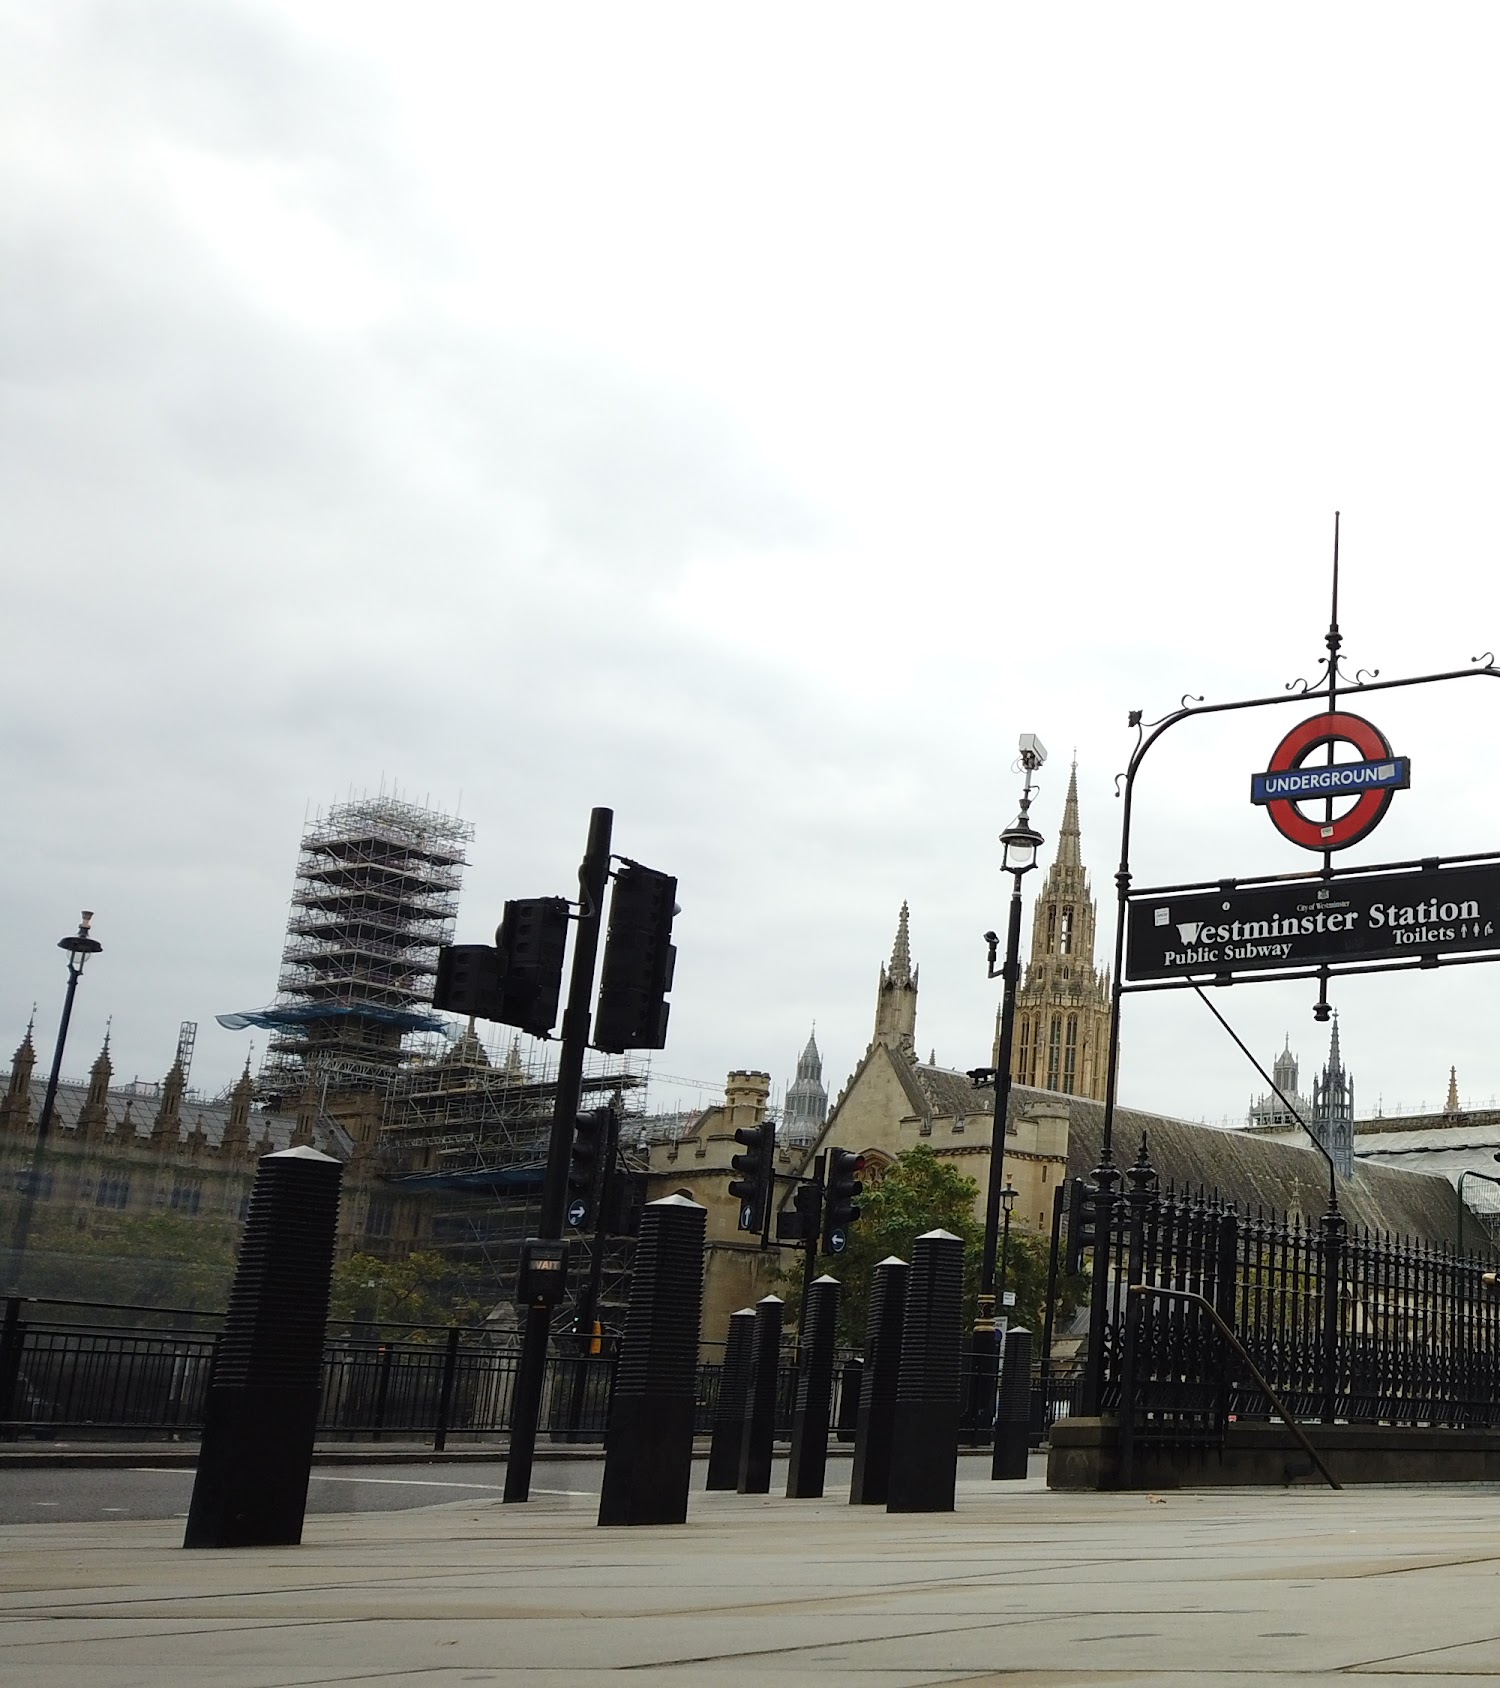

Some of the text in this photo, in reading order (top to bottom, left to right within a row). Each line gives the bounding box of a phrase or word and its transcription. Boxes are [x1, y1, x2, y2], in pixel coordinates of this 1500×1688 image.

[1176, 912, 1359, 946] Westminster
[1368, 898, 1480, 928] Station
[1392, 926, 1455, 945] Toilets
[1164, 943, 1293, 966] Public Subway
